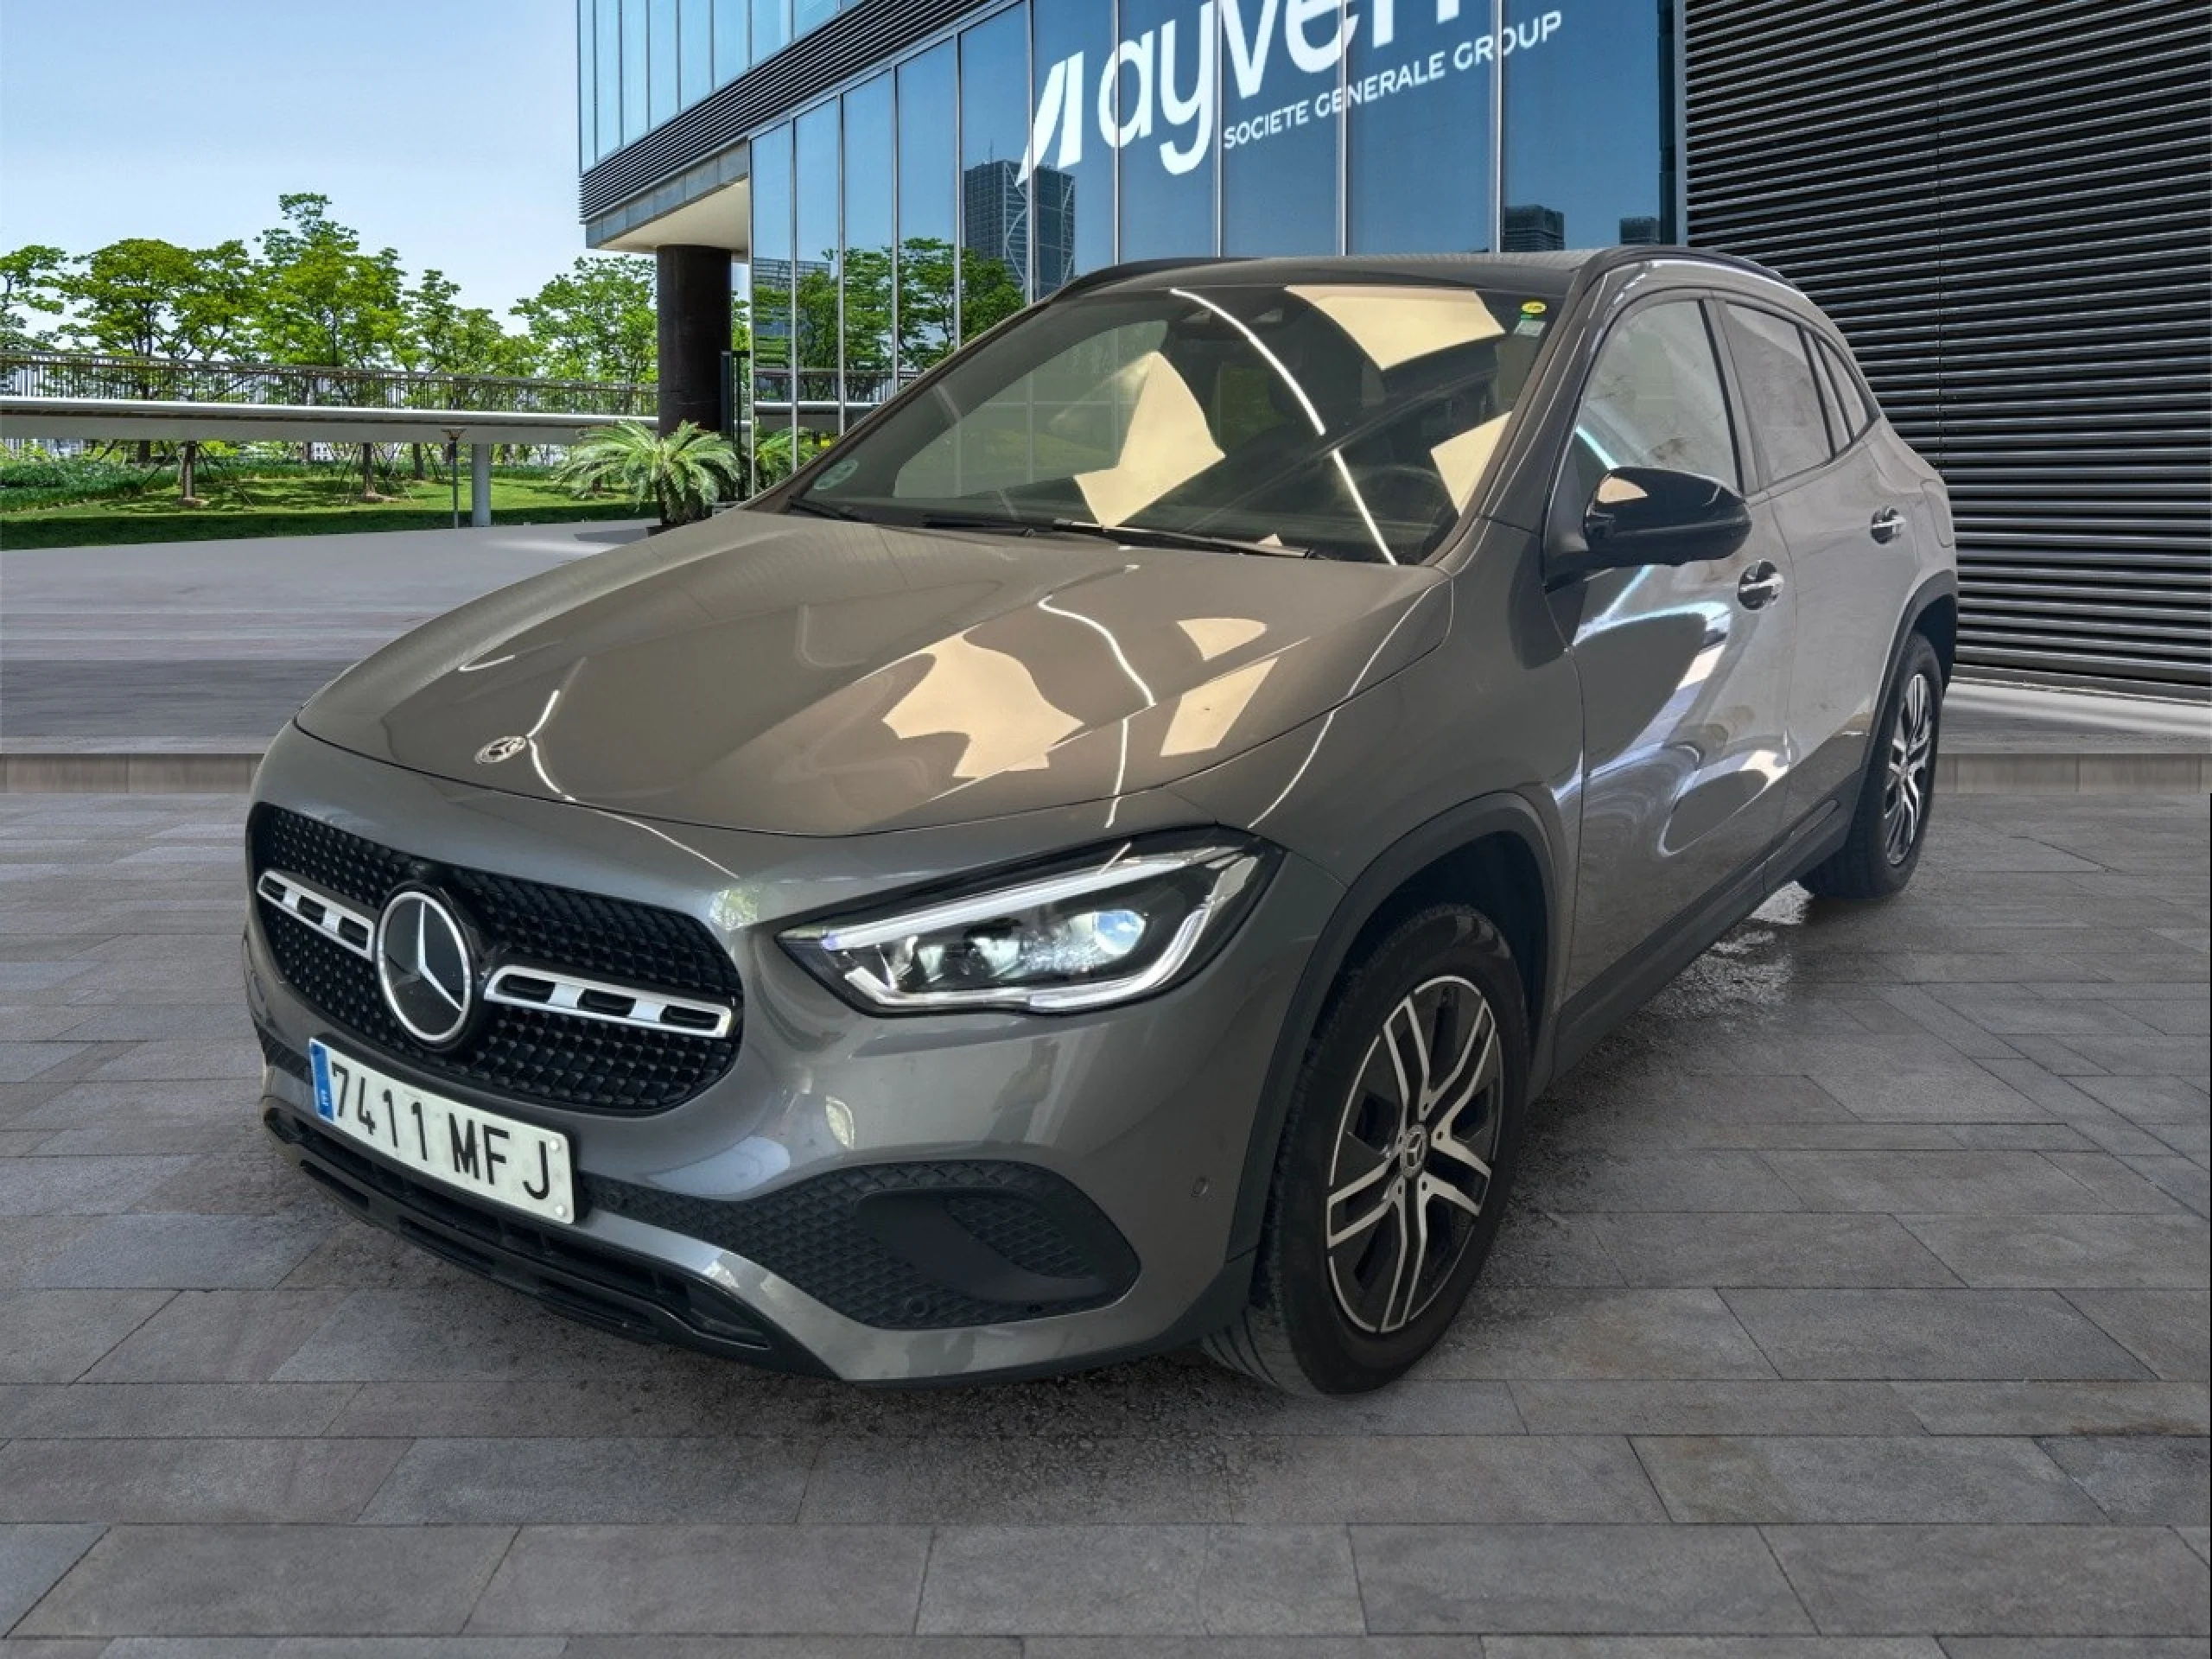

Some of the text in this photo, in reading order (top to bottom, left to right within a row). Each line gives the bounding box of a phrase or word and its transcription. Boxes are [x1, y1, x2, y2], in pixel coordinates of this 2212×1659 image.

[1223, 10, 1561, 149] SOCIETE GENERALE GROUP
[331, 1061, 550, 1200] 7411 MFJ
